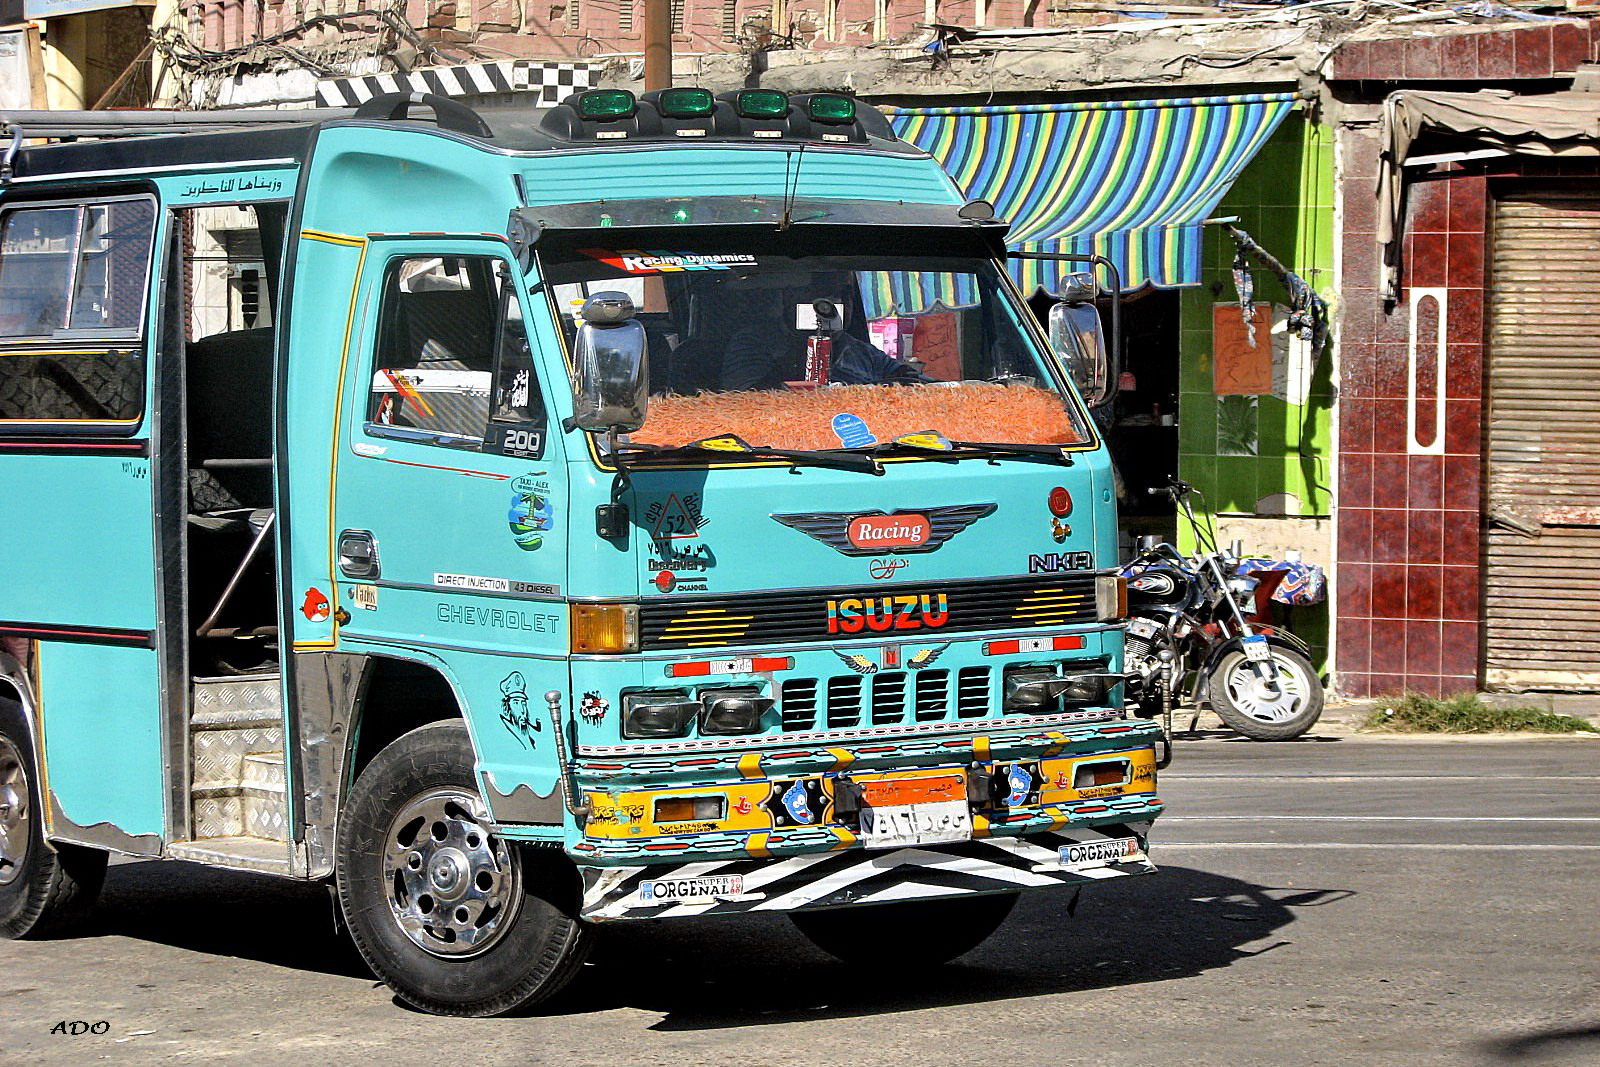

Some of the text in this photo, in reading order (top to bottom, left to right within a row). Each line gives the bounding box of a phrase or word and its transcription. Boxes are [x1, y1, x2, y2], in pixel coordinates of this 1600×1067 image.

[180, 175, 282, 198] وزيناها للناظرين
[621, 253, 756, 271] Racing Dynamics
[503, 430, 540, 451] 200
[519, 477, 532, 486] TAXI
[535, 480, 549, 489] ALEX
[664, 515, 685, 534] 52
[858, 521, 923, 542] Racing
[437, 575, 466, 586] DIRECT
[467, 577, 507, 590] INJECTION
[526, 584, 555, 594] DIESEL
[677, 584, 709, 592] CHANNEL
[437, 603, 560, 633] CHEVROLET
[826, 593, 950, 633] ISUZU
[1069, 844, 1128, 863] ORGENAL
[1100, 841, 1127, 850] SUPER
[653, 881, 730, 899] ORGENAL
[696, 877, 729, 886] SUPER
